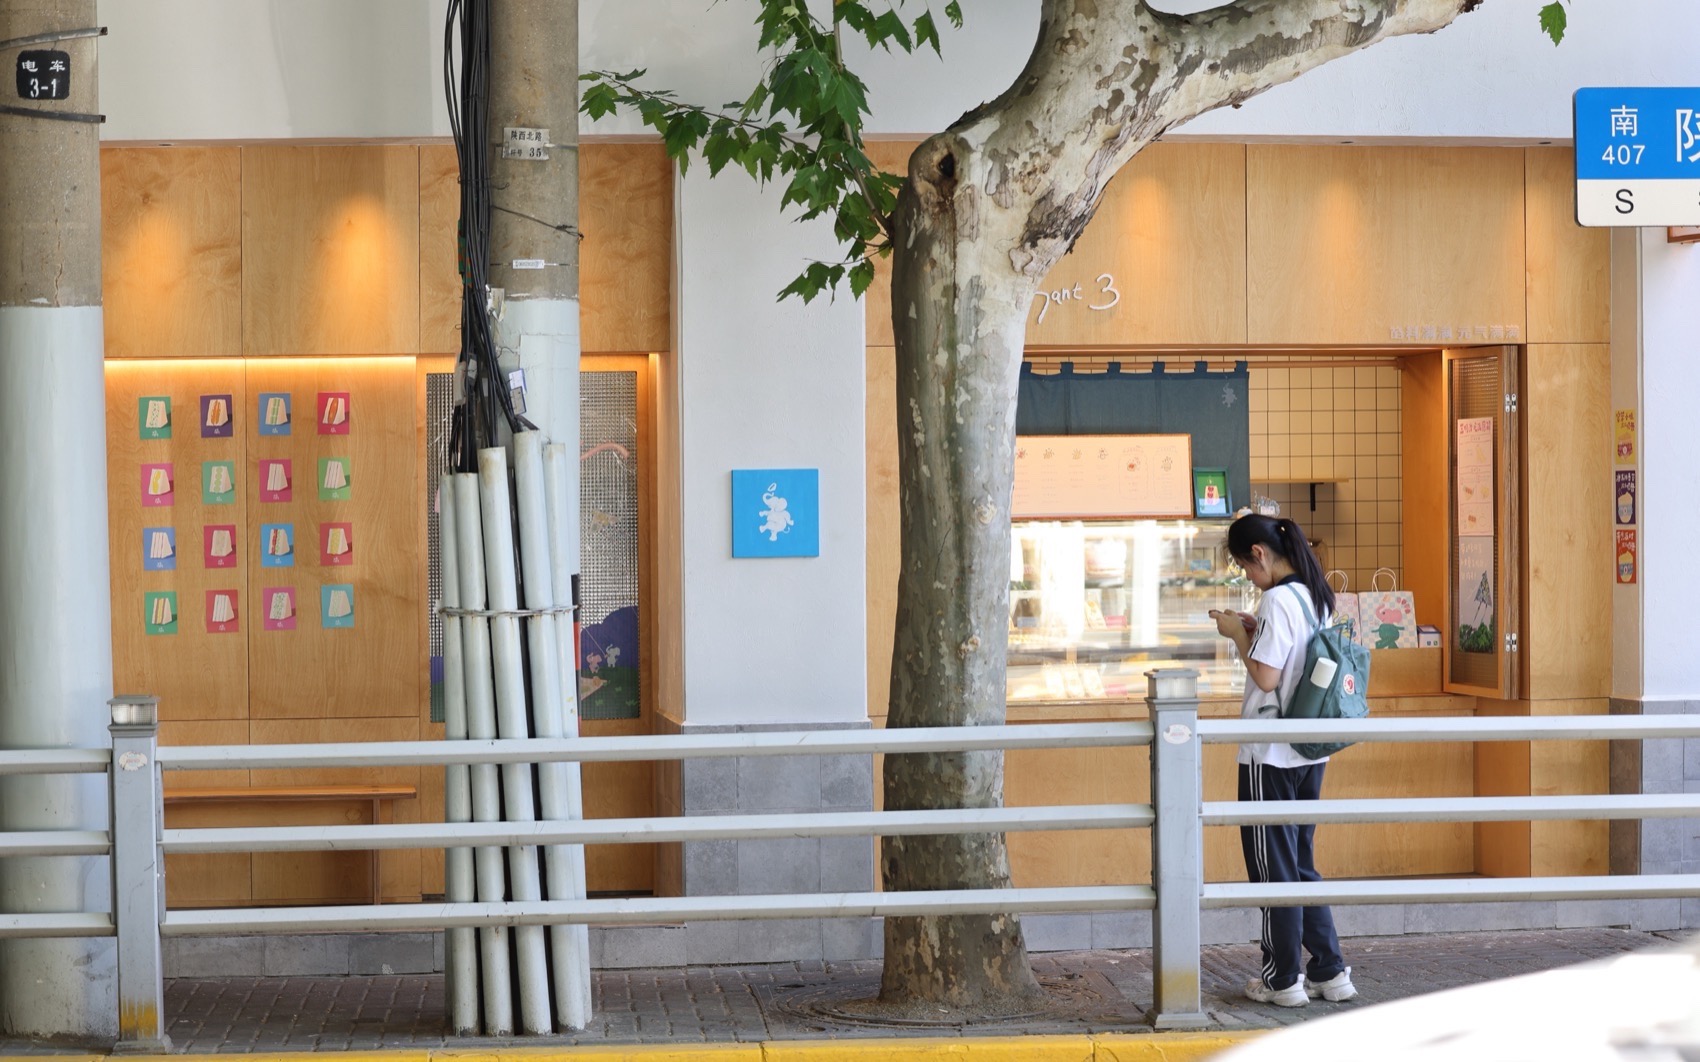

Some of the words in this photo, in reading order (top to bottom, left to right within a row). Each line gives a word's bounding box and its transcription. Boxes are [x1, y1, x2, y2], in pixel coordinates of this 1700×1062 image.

[22, 60, 65, 72] 电车
[30, 78, 57, 98] 3-1
[1610, 104, 1639, 138] 南
[511, 130, 542, 141] 陕西北路
[529, 147, 542, 157] 35
[1601, 144, 1646, 165] 407
[1615, 188, 1635, 214] S
[1088, 273, 1120, 310] 3
